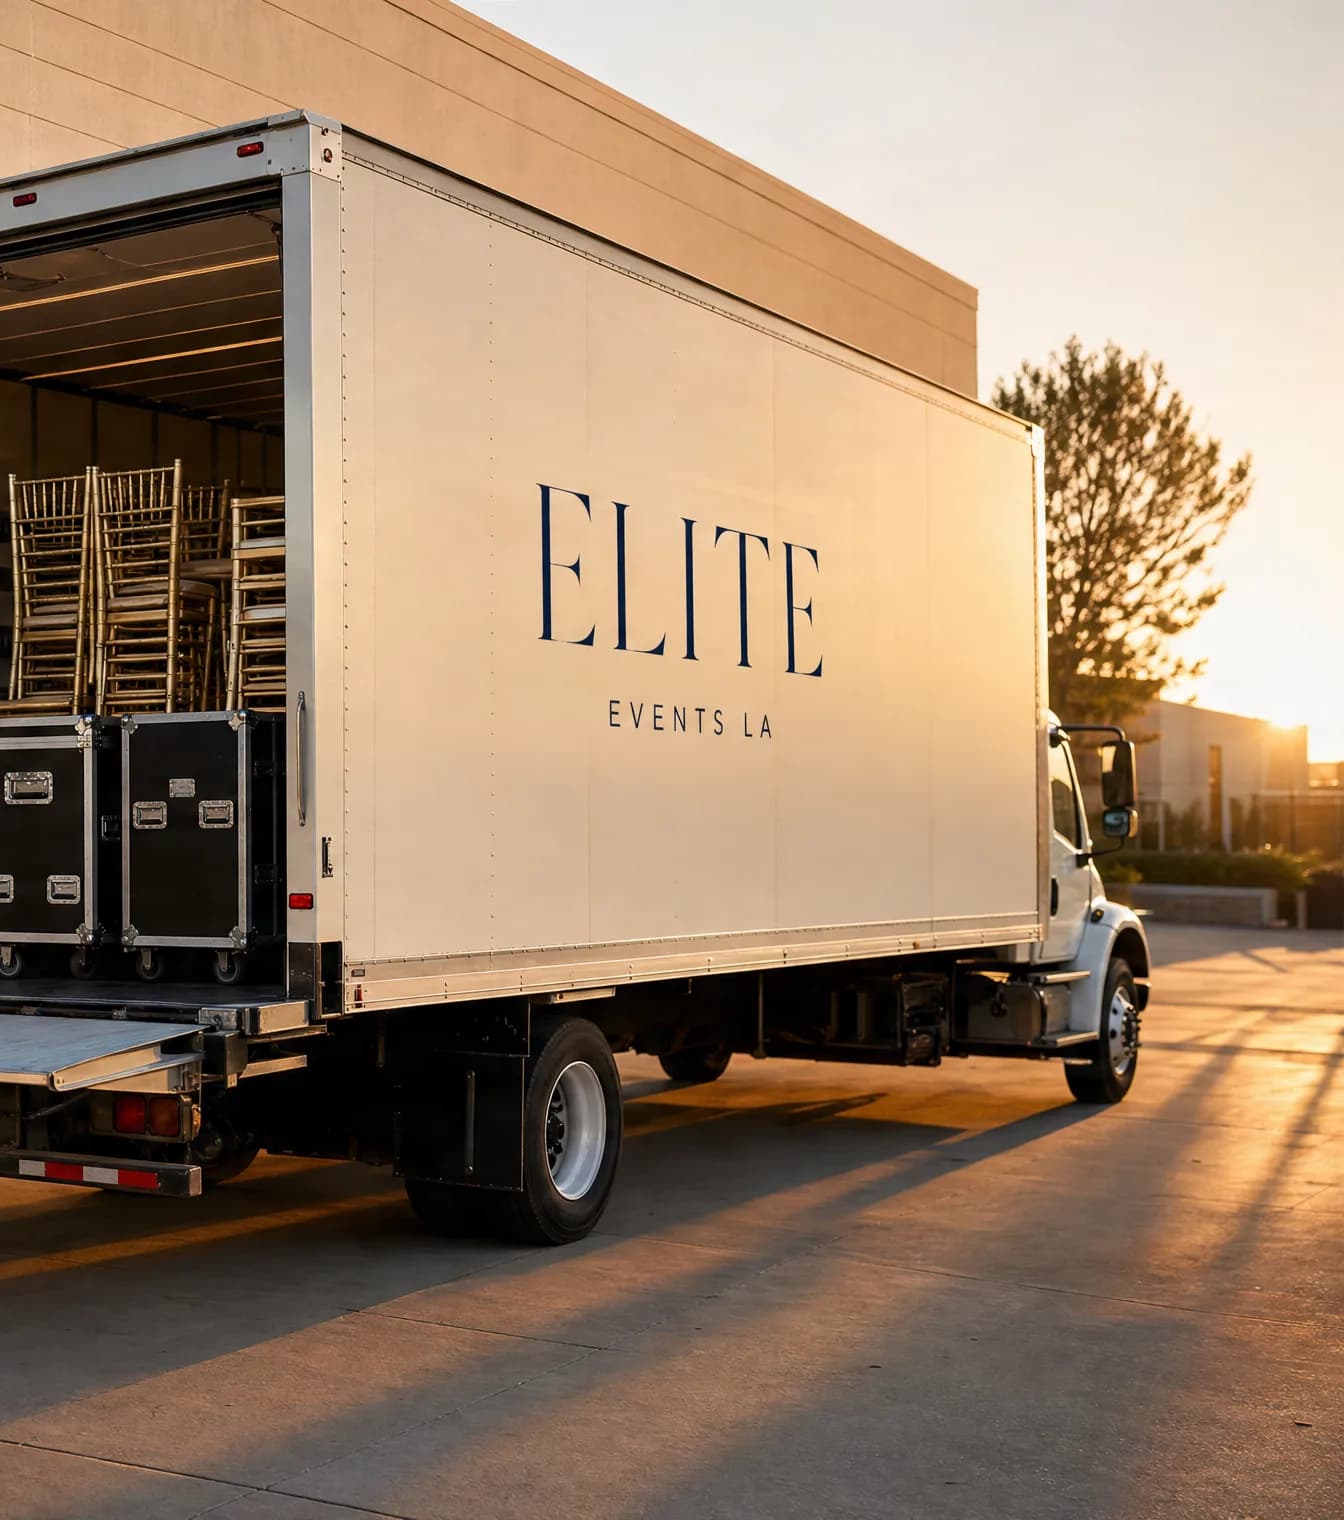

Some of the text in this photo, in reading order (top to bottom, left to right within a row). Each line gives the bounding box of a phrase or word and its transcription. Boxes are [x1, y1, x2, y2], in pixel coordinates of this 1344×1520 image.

[536, 483, 823, 677] ELITE
[609, 700, 772, 739] EVENTS LA
